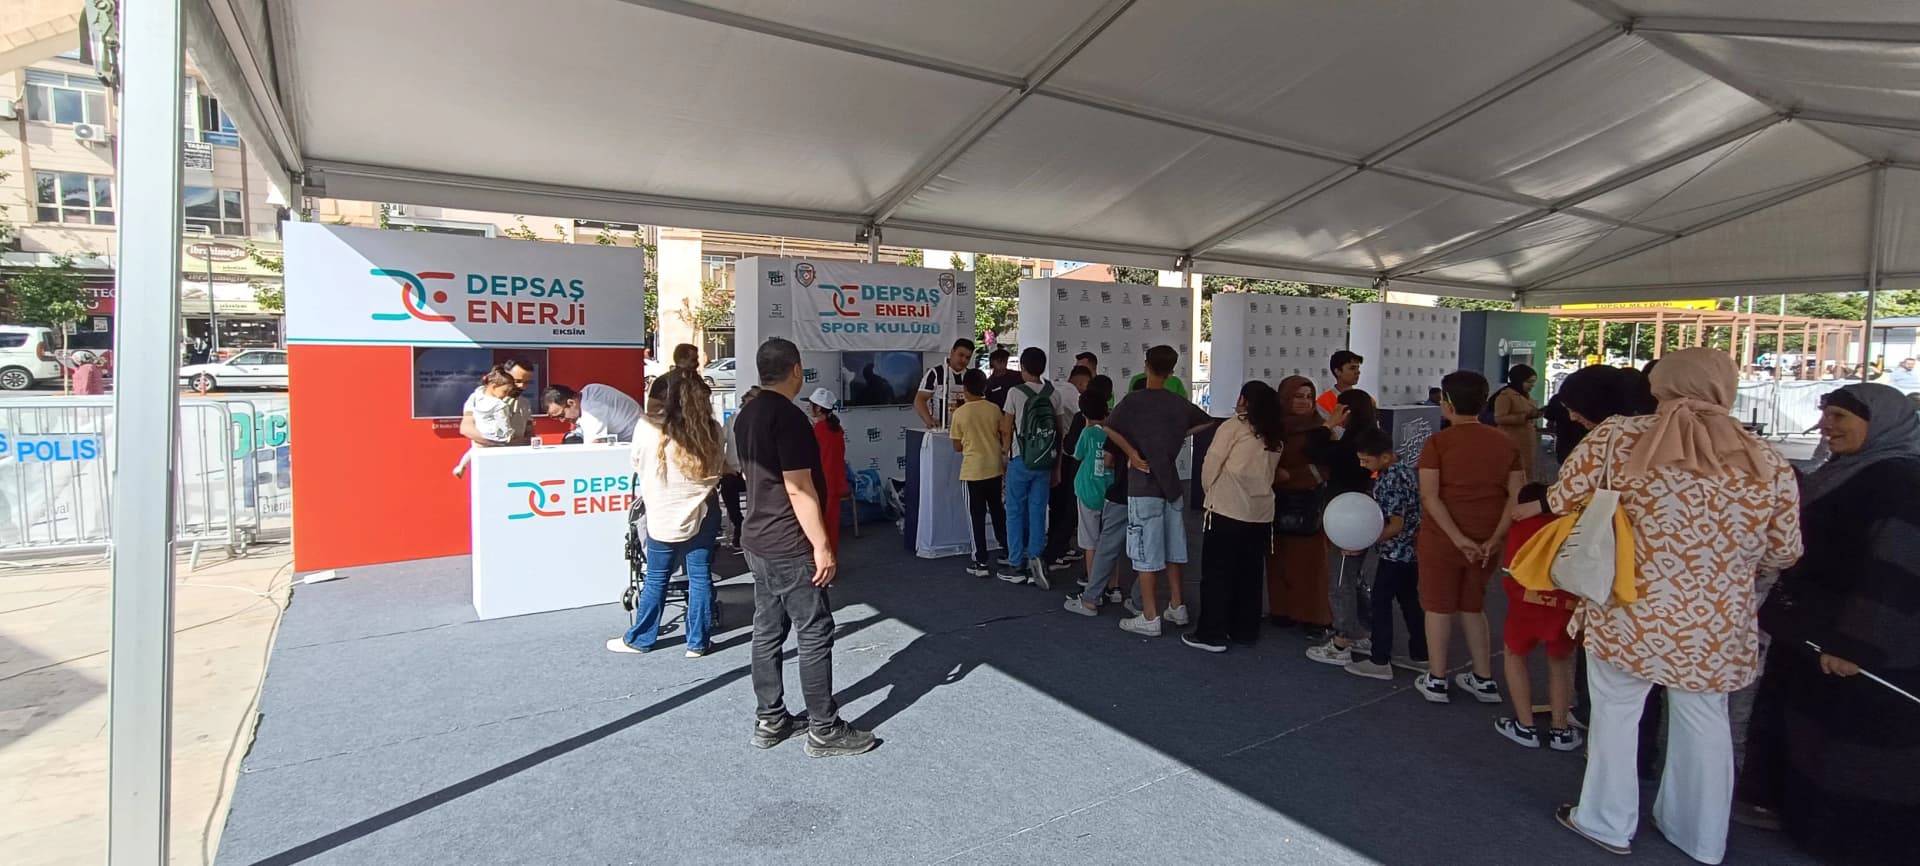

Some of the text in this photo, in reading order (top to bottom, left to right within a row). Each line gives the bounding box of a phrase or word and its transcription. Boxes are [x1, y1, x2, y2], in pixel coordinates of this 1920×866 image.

[467, 274, 585, 302] DEPSAŞ
[861, 285, 940, 307] DEPSAŞ
[875, 304, 931, 318] ENERJİ
[821, 322, 942, 335] SPOR KULÜBÜ
